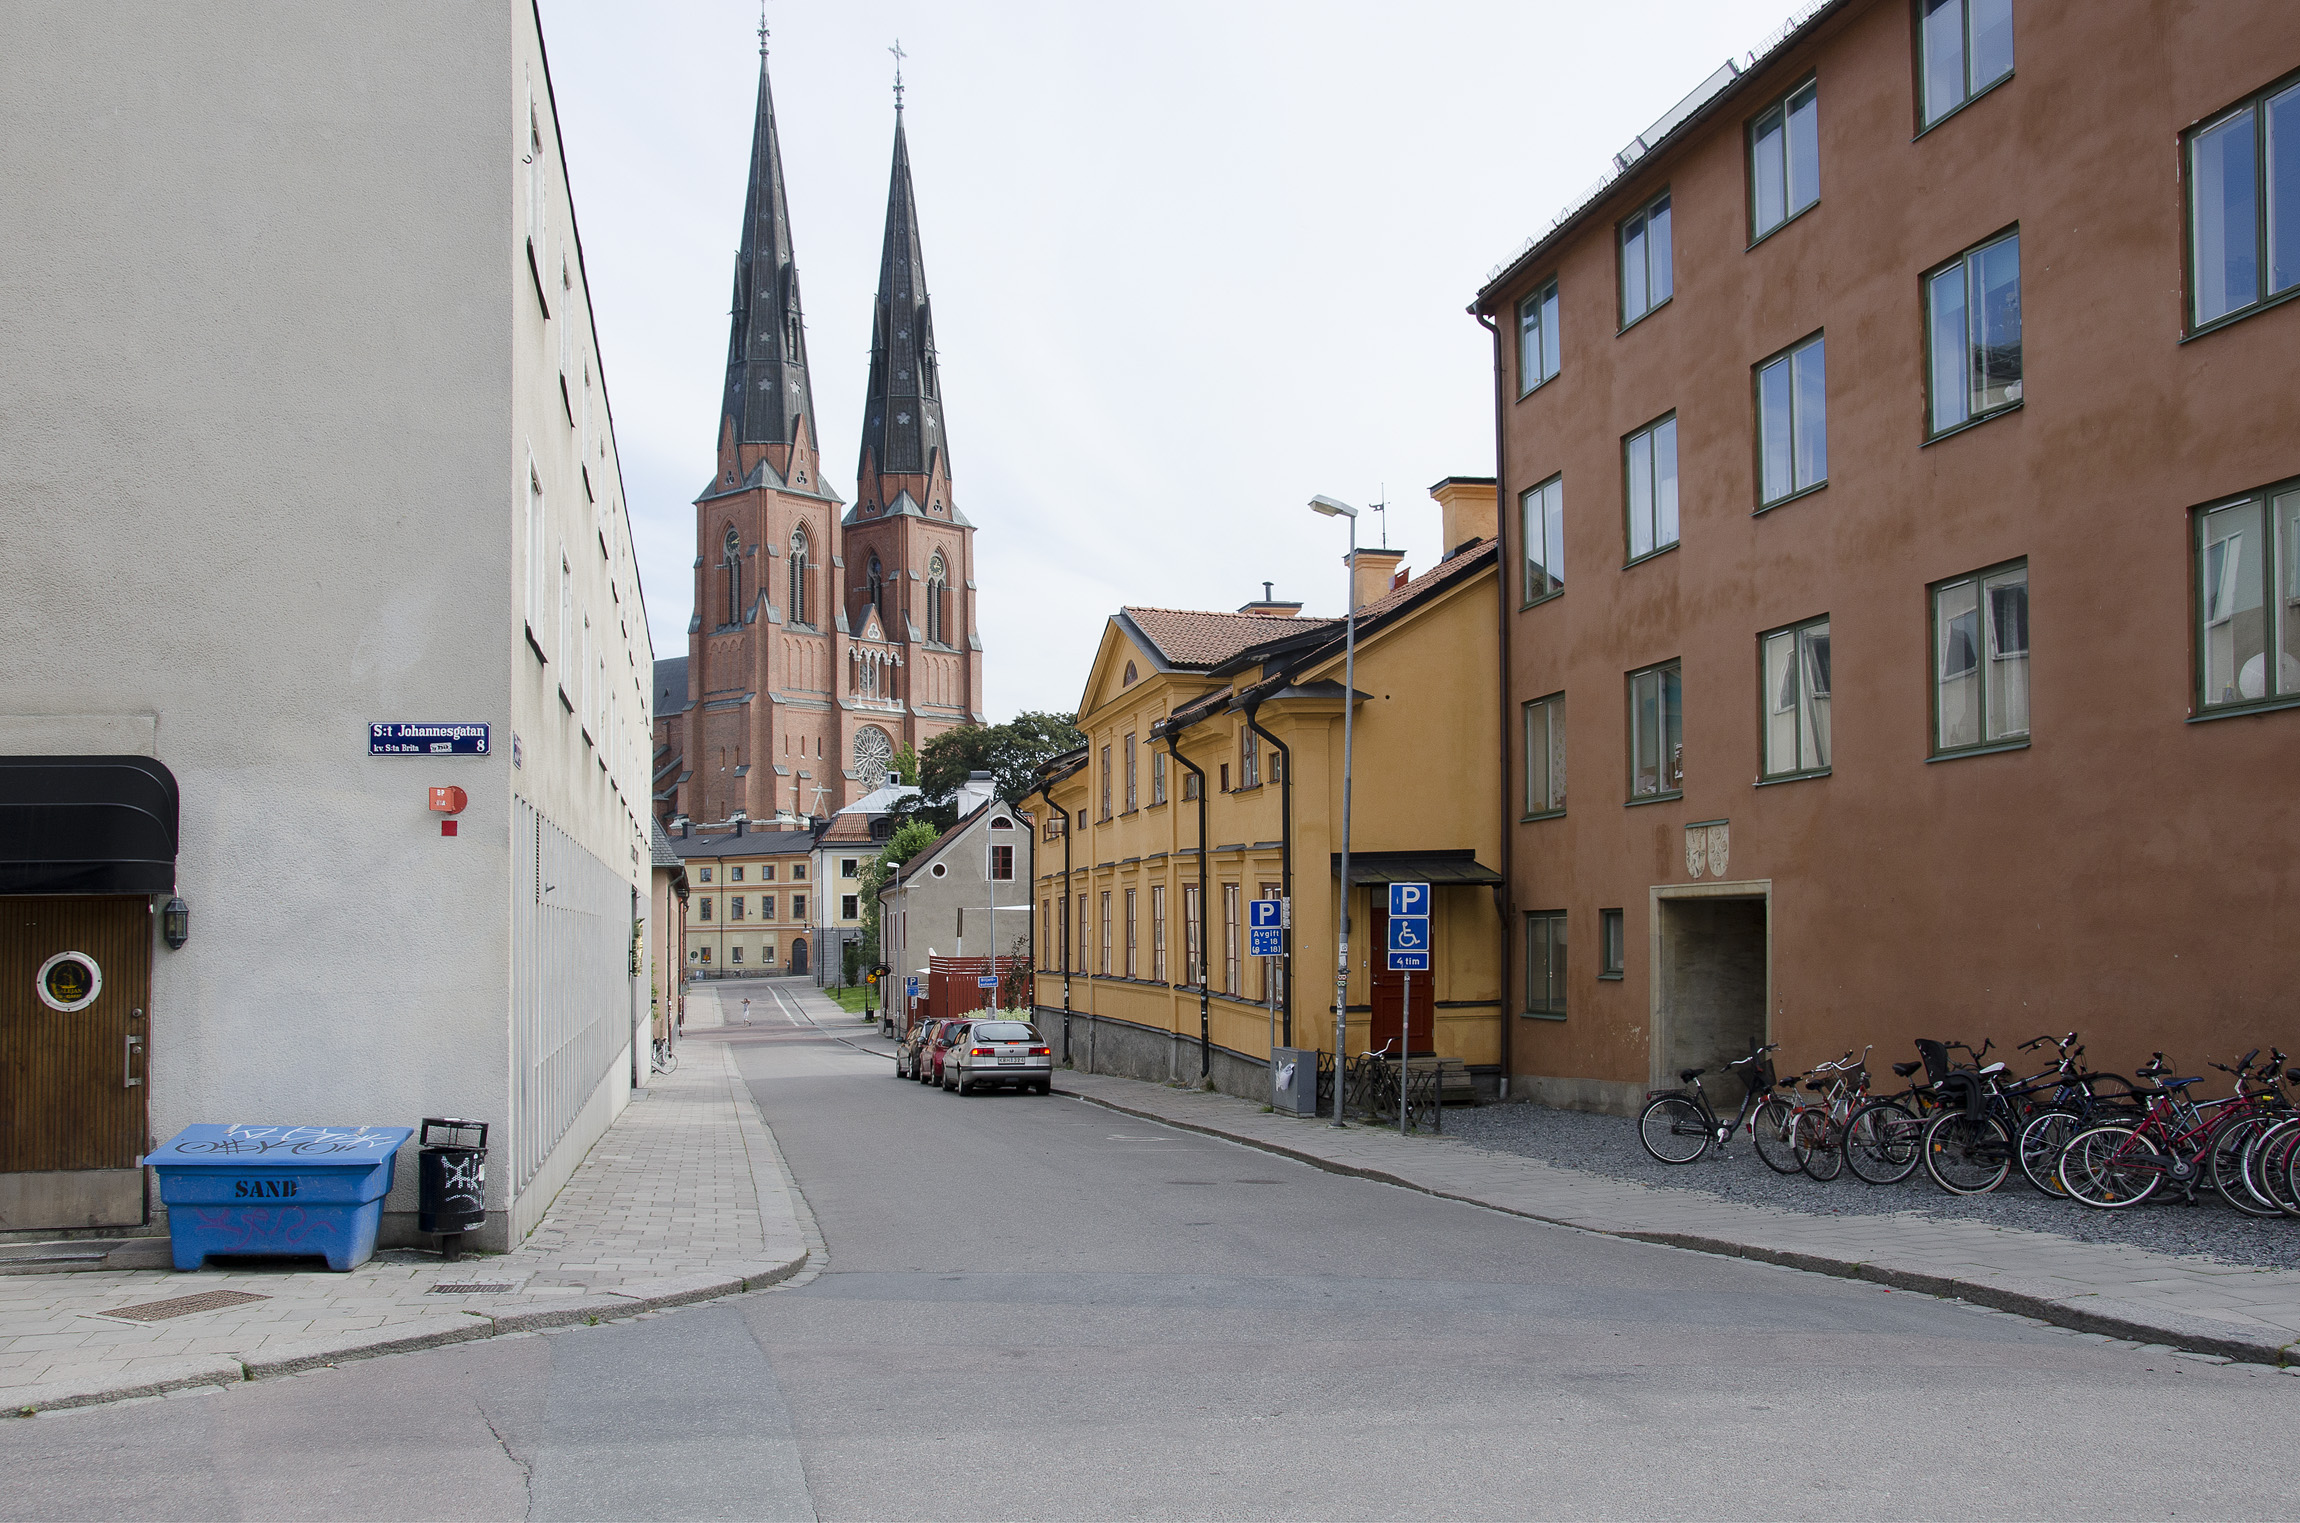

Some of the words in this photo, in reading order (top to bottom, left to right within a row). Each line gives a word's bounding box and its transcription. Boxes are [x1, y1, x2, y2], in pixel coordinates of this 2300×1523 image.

[374, 725, 392, 737] S:t
[398, 725, 485, 740] Johannesgatan
[385, 744, 400, 752] S:ta
[402, 744, 419, 752] Brita
[476, 739, 485, 752] 8
[1402, 886, 1420, 913] P
[1260, 903, 1275, 925] P
[1253, 930, 1279, 939] Avgift
[1396, 957, 1403, 966] 4
[1405, 957, 1420, 966] tim
[910, 977, 916, 986] P
[235, 1180, 298, 1198] SAND
